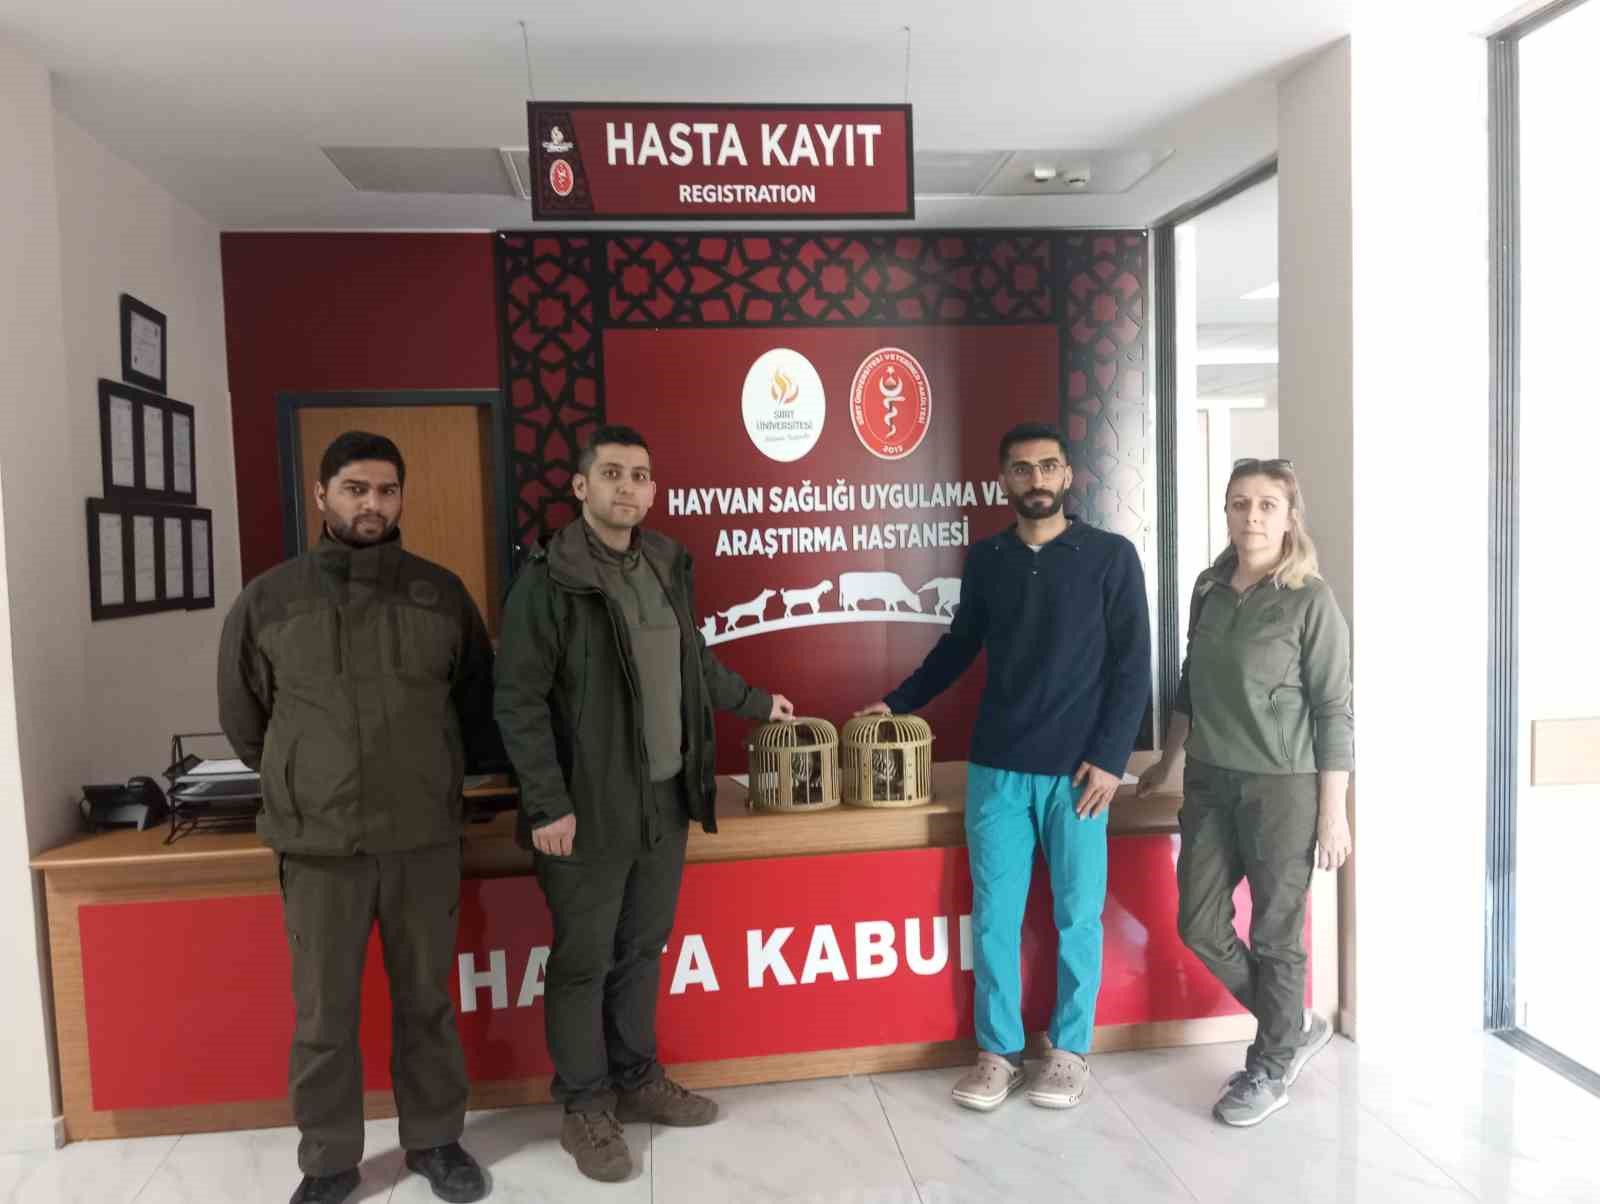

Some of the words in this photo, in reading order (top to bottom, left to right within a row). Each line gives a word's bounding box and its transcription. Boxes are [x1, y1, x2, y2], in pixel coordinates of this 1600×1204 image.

[606, 122, 747, 167] HASTA
[762, 123, 882, 167] KAYIT
[679, 184, 816, 204] REGISTRATION
[668, 486, 763, 516] HAYVAN
[769, 477, 855, 514] SAĞLIĞI
[861, 482, 977, 511] UYGULAMA
[982, 481, 1009, 506] VE
[715, 527, 848, 560] ARAŞTIRMA
[853, 515, 969, 553] HASTANESİ
[458, 934, 720, 1013] HAA
